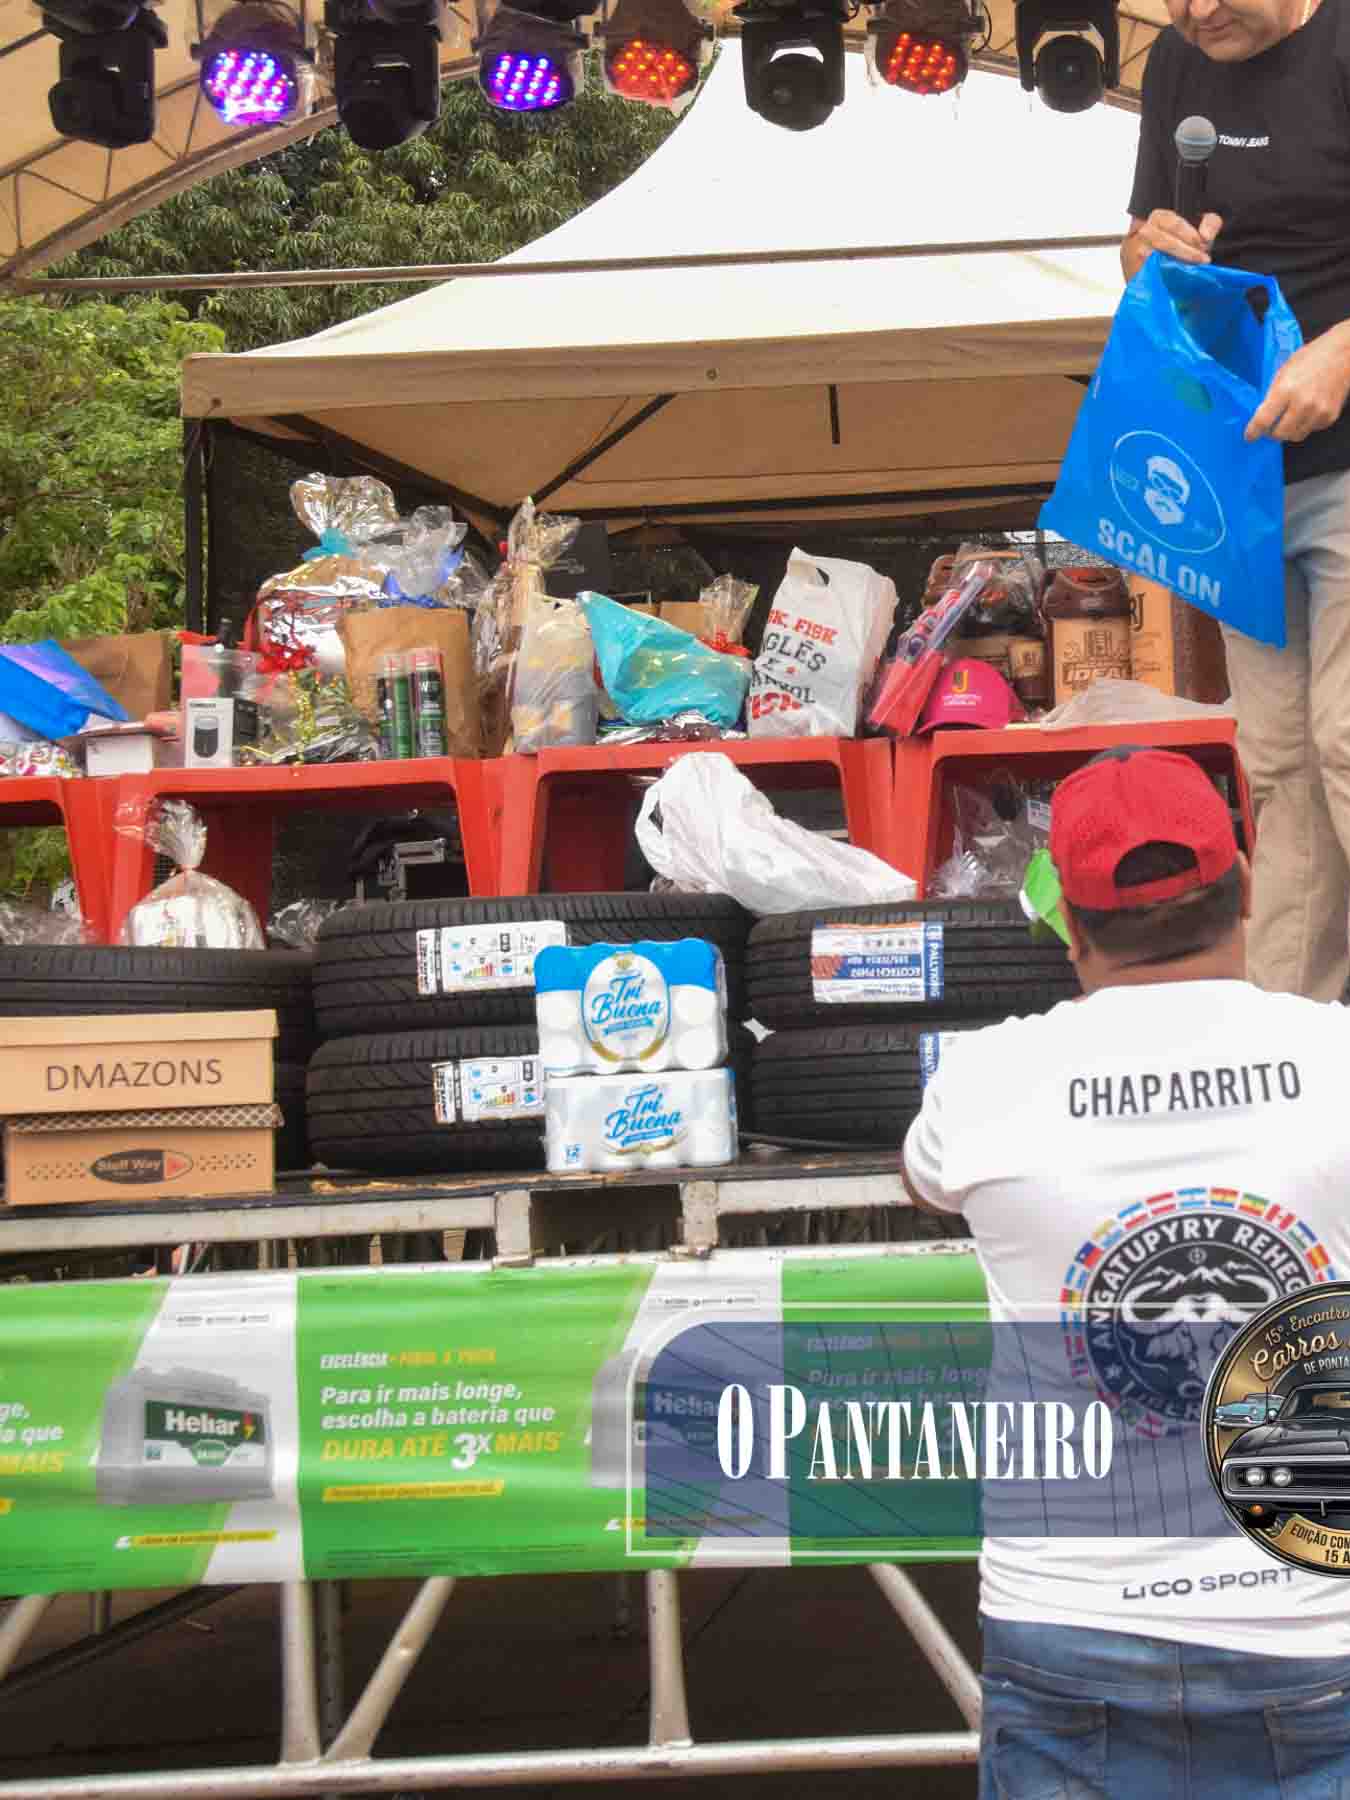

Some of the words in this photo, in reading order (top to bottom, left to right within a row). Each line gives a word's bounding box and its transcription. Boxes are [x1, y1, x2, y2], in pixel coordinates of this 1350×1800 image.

[1218, 134, 1246, 147] TOMMY
[1097, 517, 1223, 609] SCALON
[610, 974, 646, 1001] Tri
[591, 993, 662, 1025] Buena
[46, 1058, 223, 1092] DMAZONS
[1068, 1060, 1301, 1118] CHAPARRITO
[625, 1086, 664, 1114] Tri
[605, 1109, 682, 1141] Buena
[131, 1158, 162, 1171] Way
[320, 1386, 372, 1405] Para
[375, 1384, 395, 1403] ir
[398, 1382, 450, 1403] mais
[455, 1380, 523, 1404] longe,
[164, 1408, 241, 1436] Heliar
[320, 1408, 407, 1430] escolha
[412, 1410, 425, 1426] a
[431, 1406, 510, 1426] bateria
[514, 1407, 556, 1427] que
[320, 1438, 395, 1461] DURA
[399, 1431, 448, 1457] ATÉ
[494, 1431, 561, 1454] MAIS
[1198, 1566, 1297, 1593] SPORT
